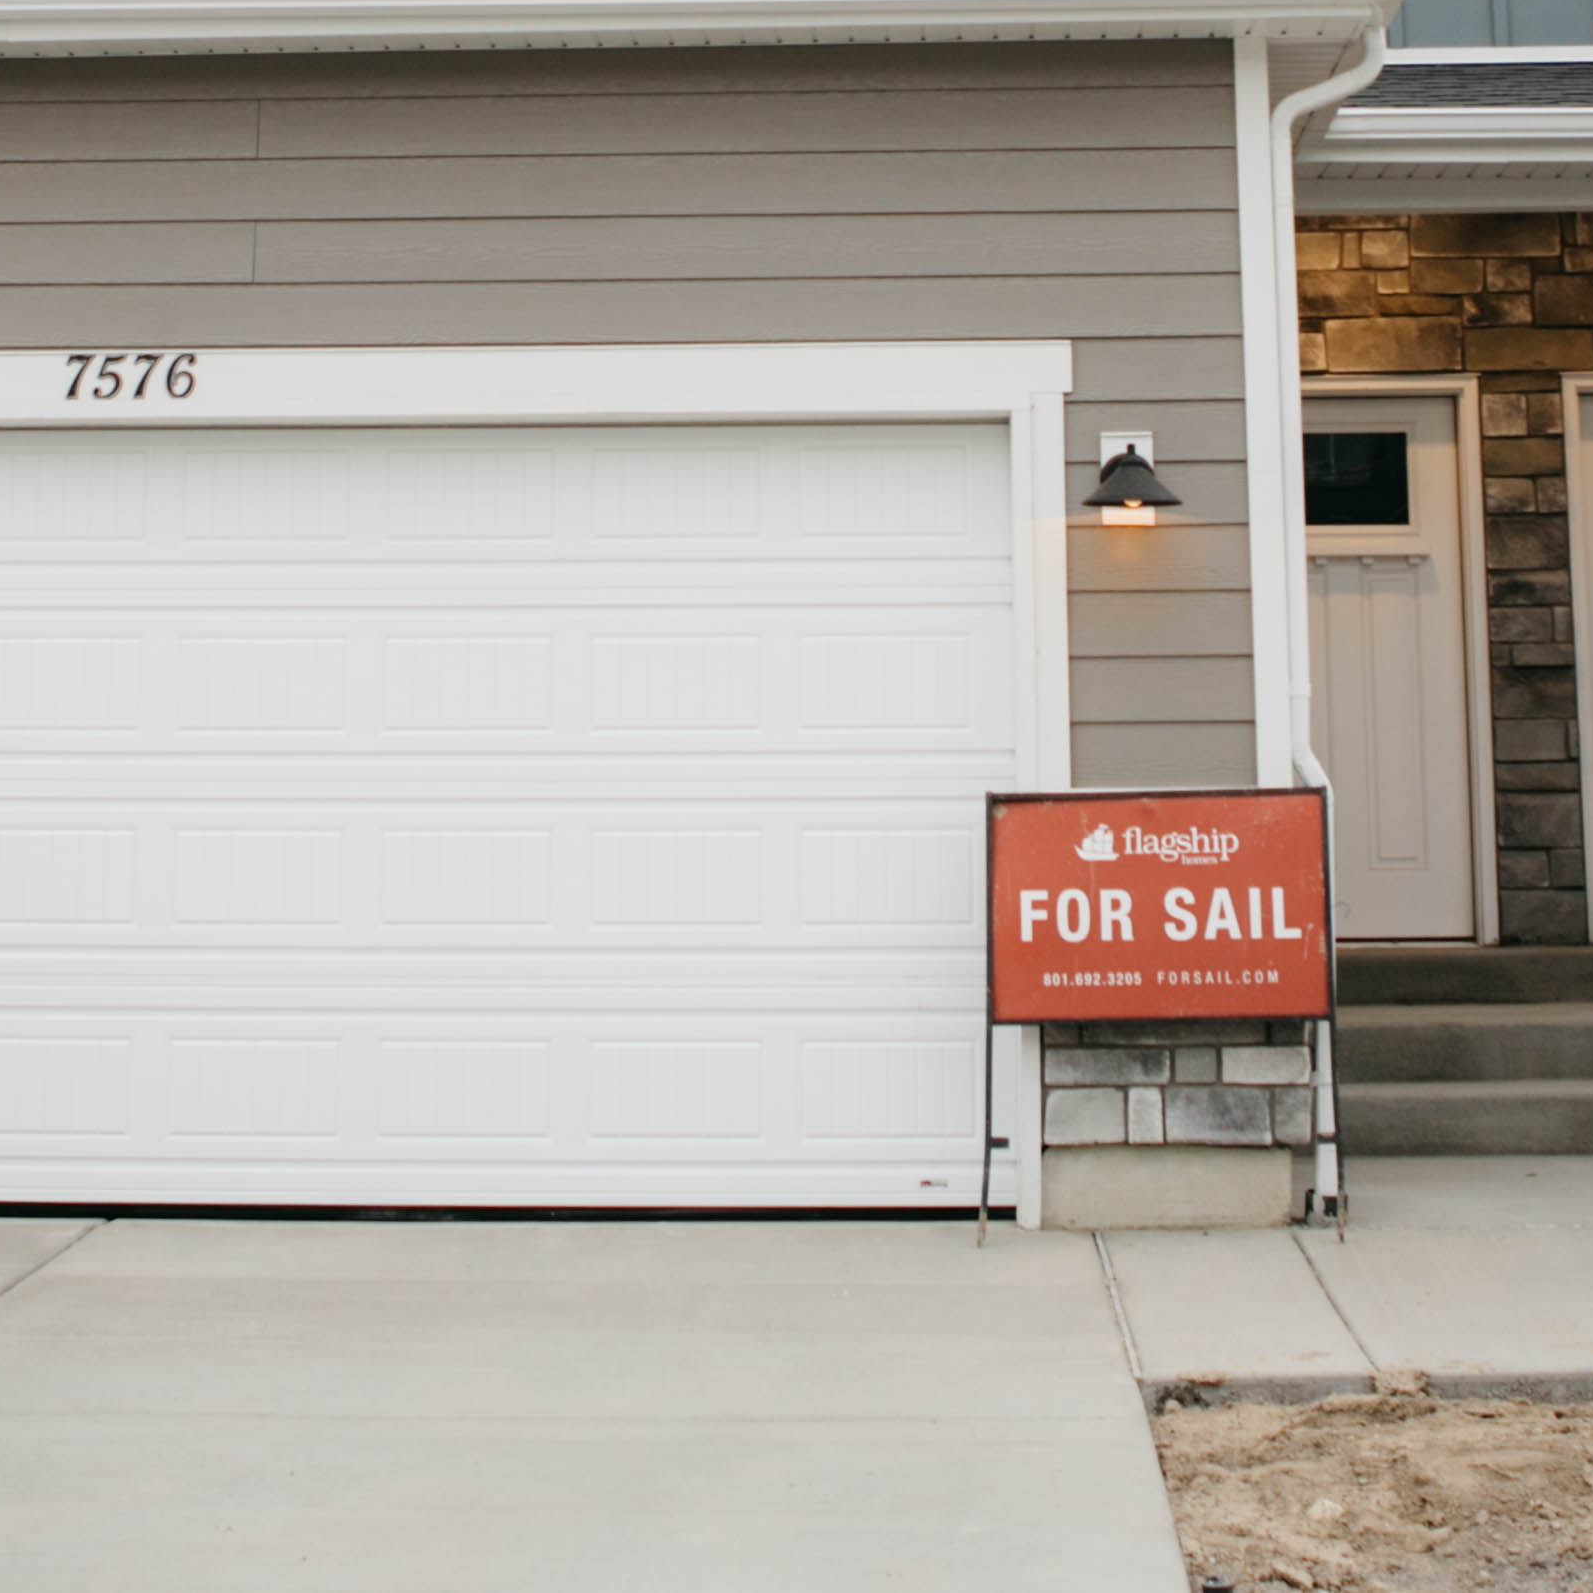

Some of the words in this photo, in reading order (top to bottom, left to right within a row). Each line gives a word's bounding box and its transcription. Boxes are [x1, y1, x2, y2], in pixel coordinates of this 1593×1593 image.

[65, 353, 198, 400] 7576
[1121, 825, 1240, 863] flagship
[1019, 888, 1134, 943] FOR
[1163, 886, 1303, 941] SAIL
[1043, 971, 1142, 987] 801.692.3205
[1157, 969, 1279, 986] FORSAIL.COM
